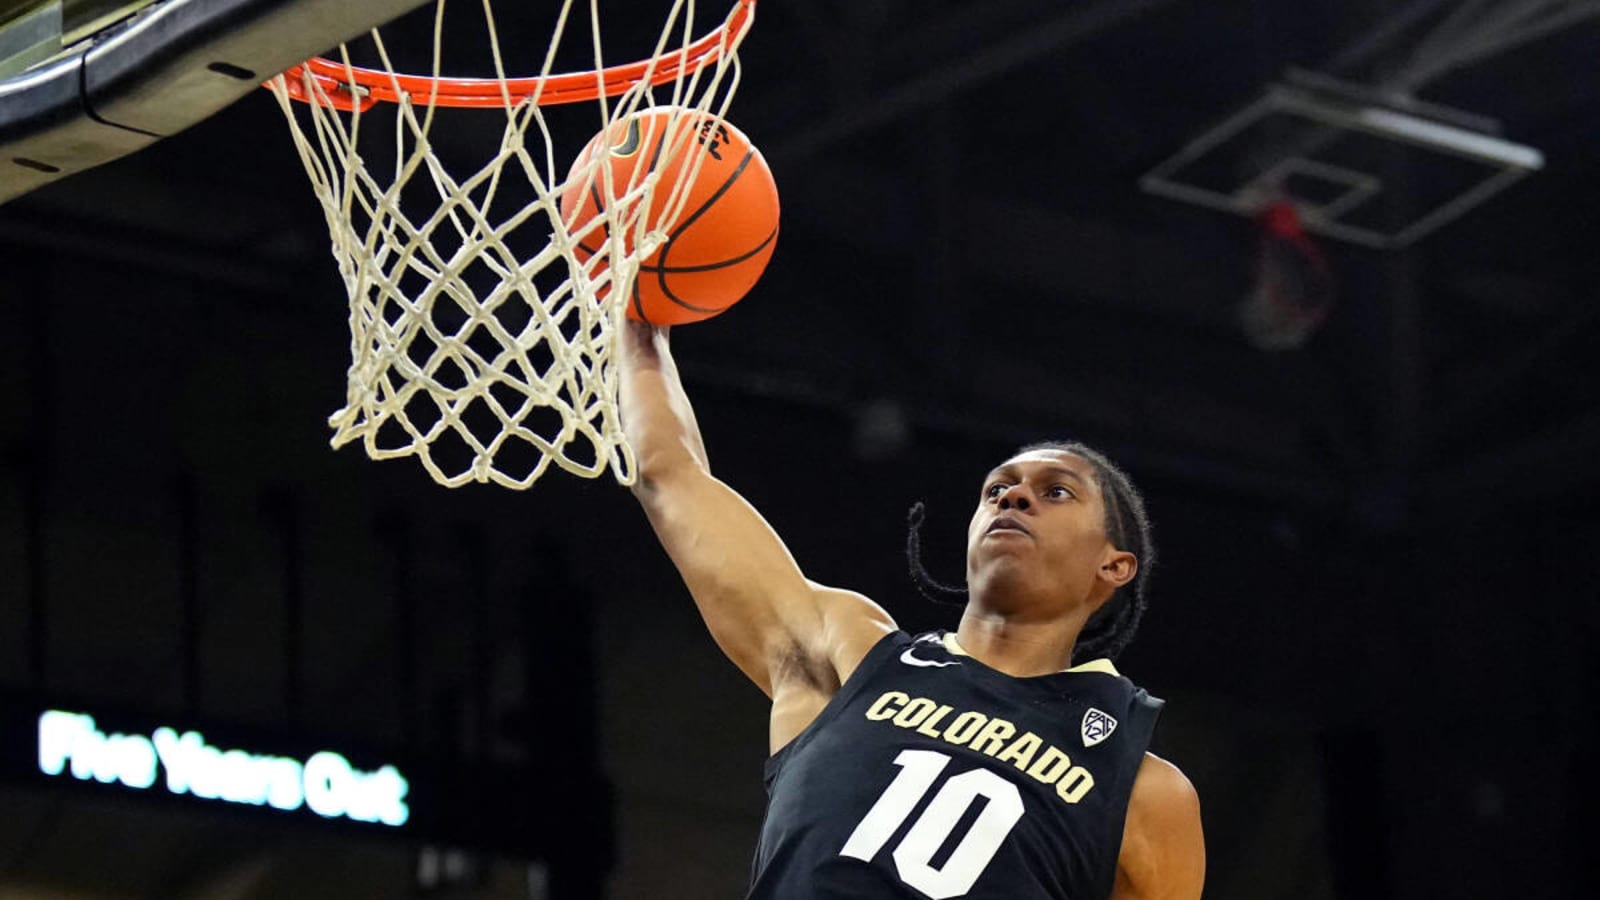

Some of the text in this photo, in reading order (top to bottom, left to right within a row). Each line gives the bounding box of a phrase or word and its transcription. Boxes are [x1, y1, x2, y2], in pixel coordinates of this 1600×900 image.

[38, 710, 409, 826] Five Years Out
[866, 691, 1095, 804] COLORADO
[1085, 711, 1115, 737] PAC
[1085, 725, 1102, 741] 12
[838, 749, 1025, 900] 10
